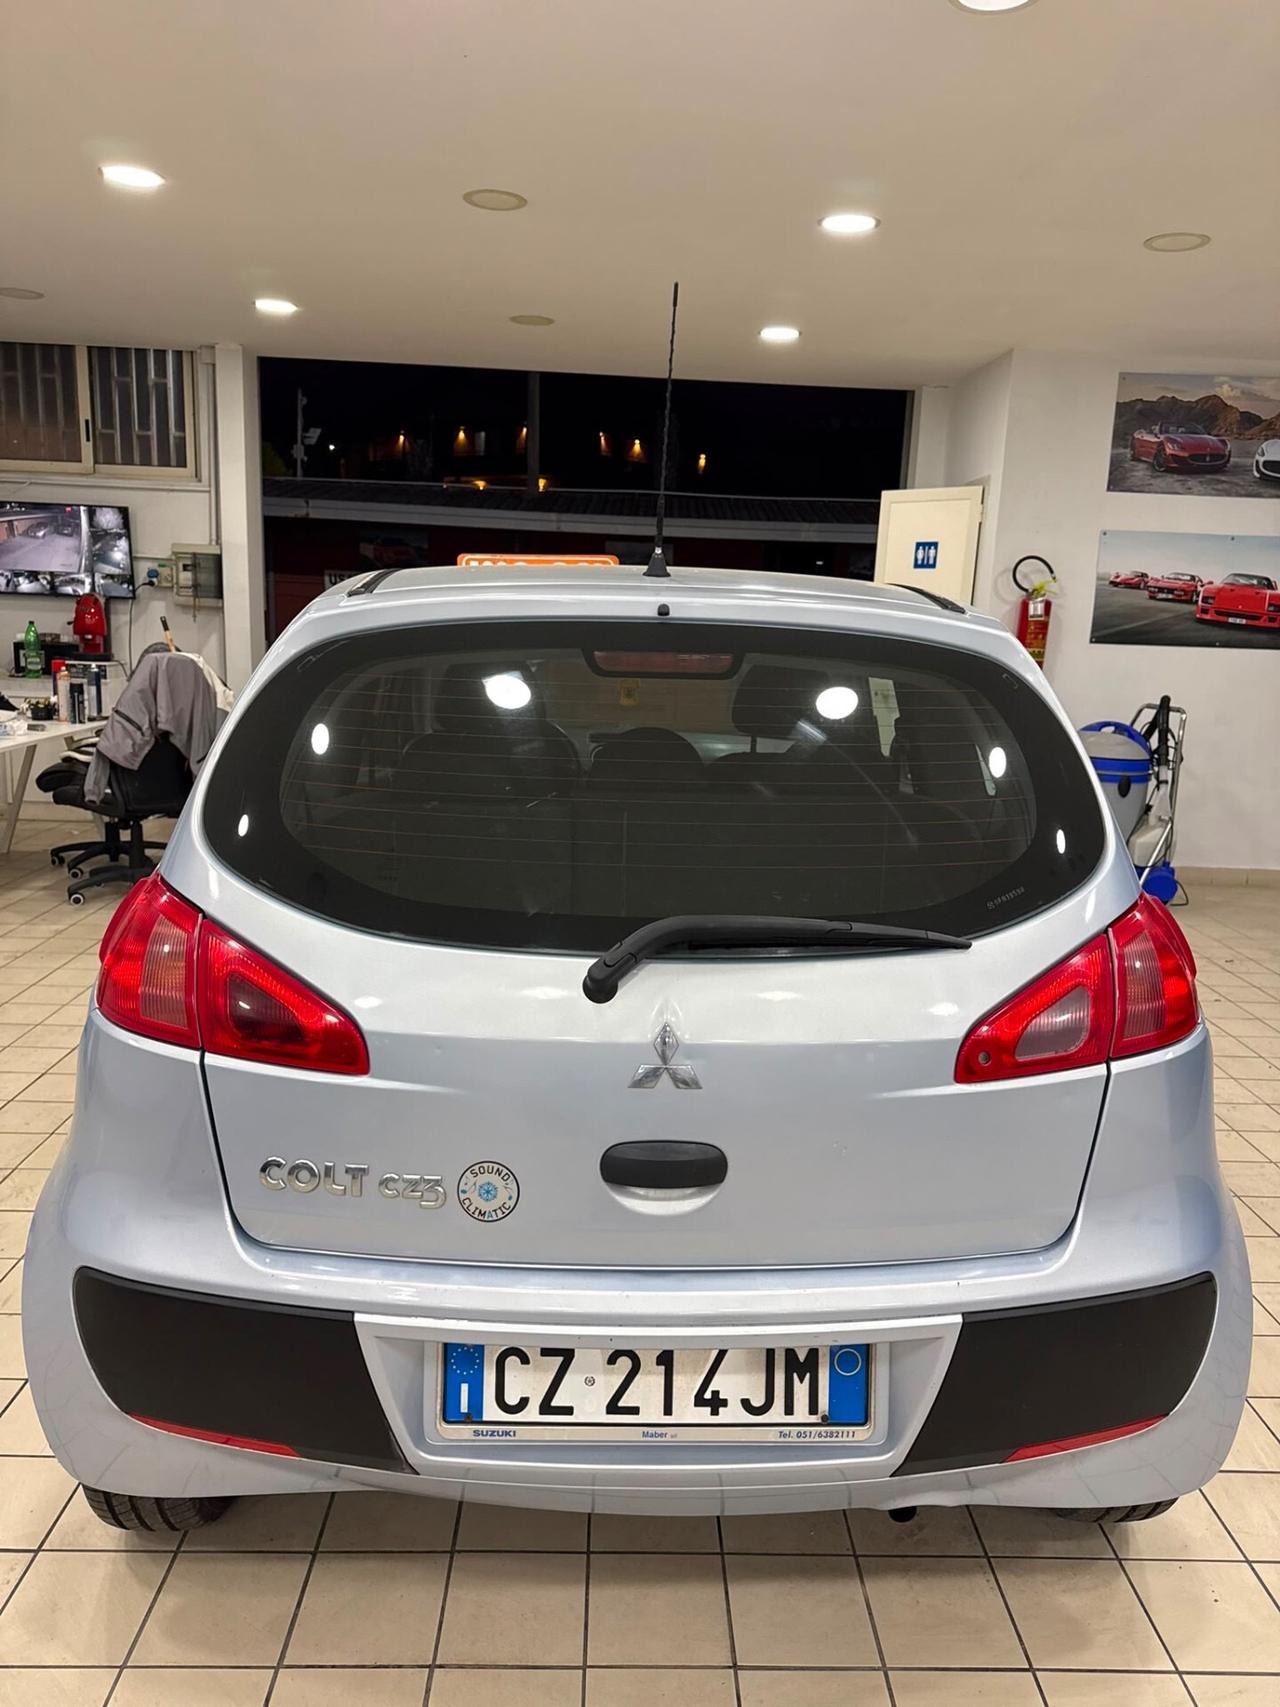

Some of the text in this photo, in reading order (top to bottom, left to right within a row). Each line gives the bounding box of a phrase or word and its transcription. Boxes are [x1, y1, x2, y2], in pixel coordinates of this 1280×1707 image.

[258, 1156, 369, 1198] COLT
[470, 1165, 511, 1182] SOUND
[462, 1197, 511, 1219] CLIMATIC
[495, 1346, 576, 1416] CZ
[472, 1429, 517, 1438] SUZUKI
[641, 1430, 669, 1439] Maber
[778, 1430, 856, 1440] Tel. 051/6382111
